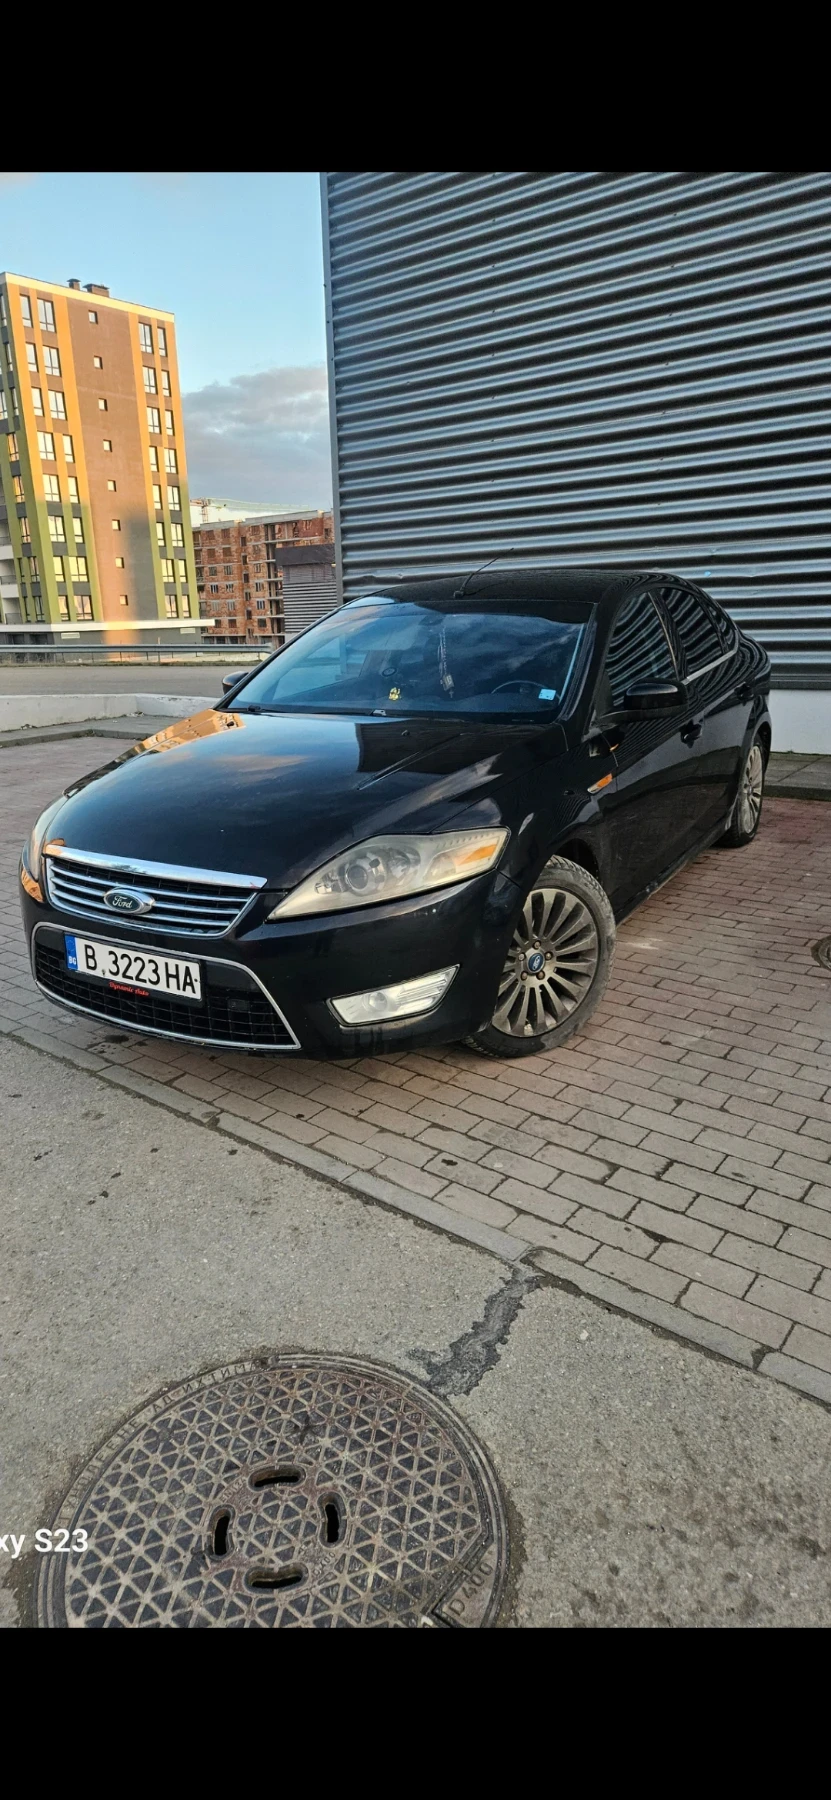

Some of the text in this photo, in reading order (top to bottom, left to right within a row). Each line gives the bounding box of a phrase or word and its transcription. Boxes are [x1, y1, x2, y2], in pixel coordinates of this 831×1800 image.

[112, 895, 133, 909] Ford
[68, 955, 77, 966] BG
[108, 950, 160, 986] 3223
